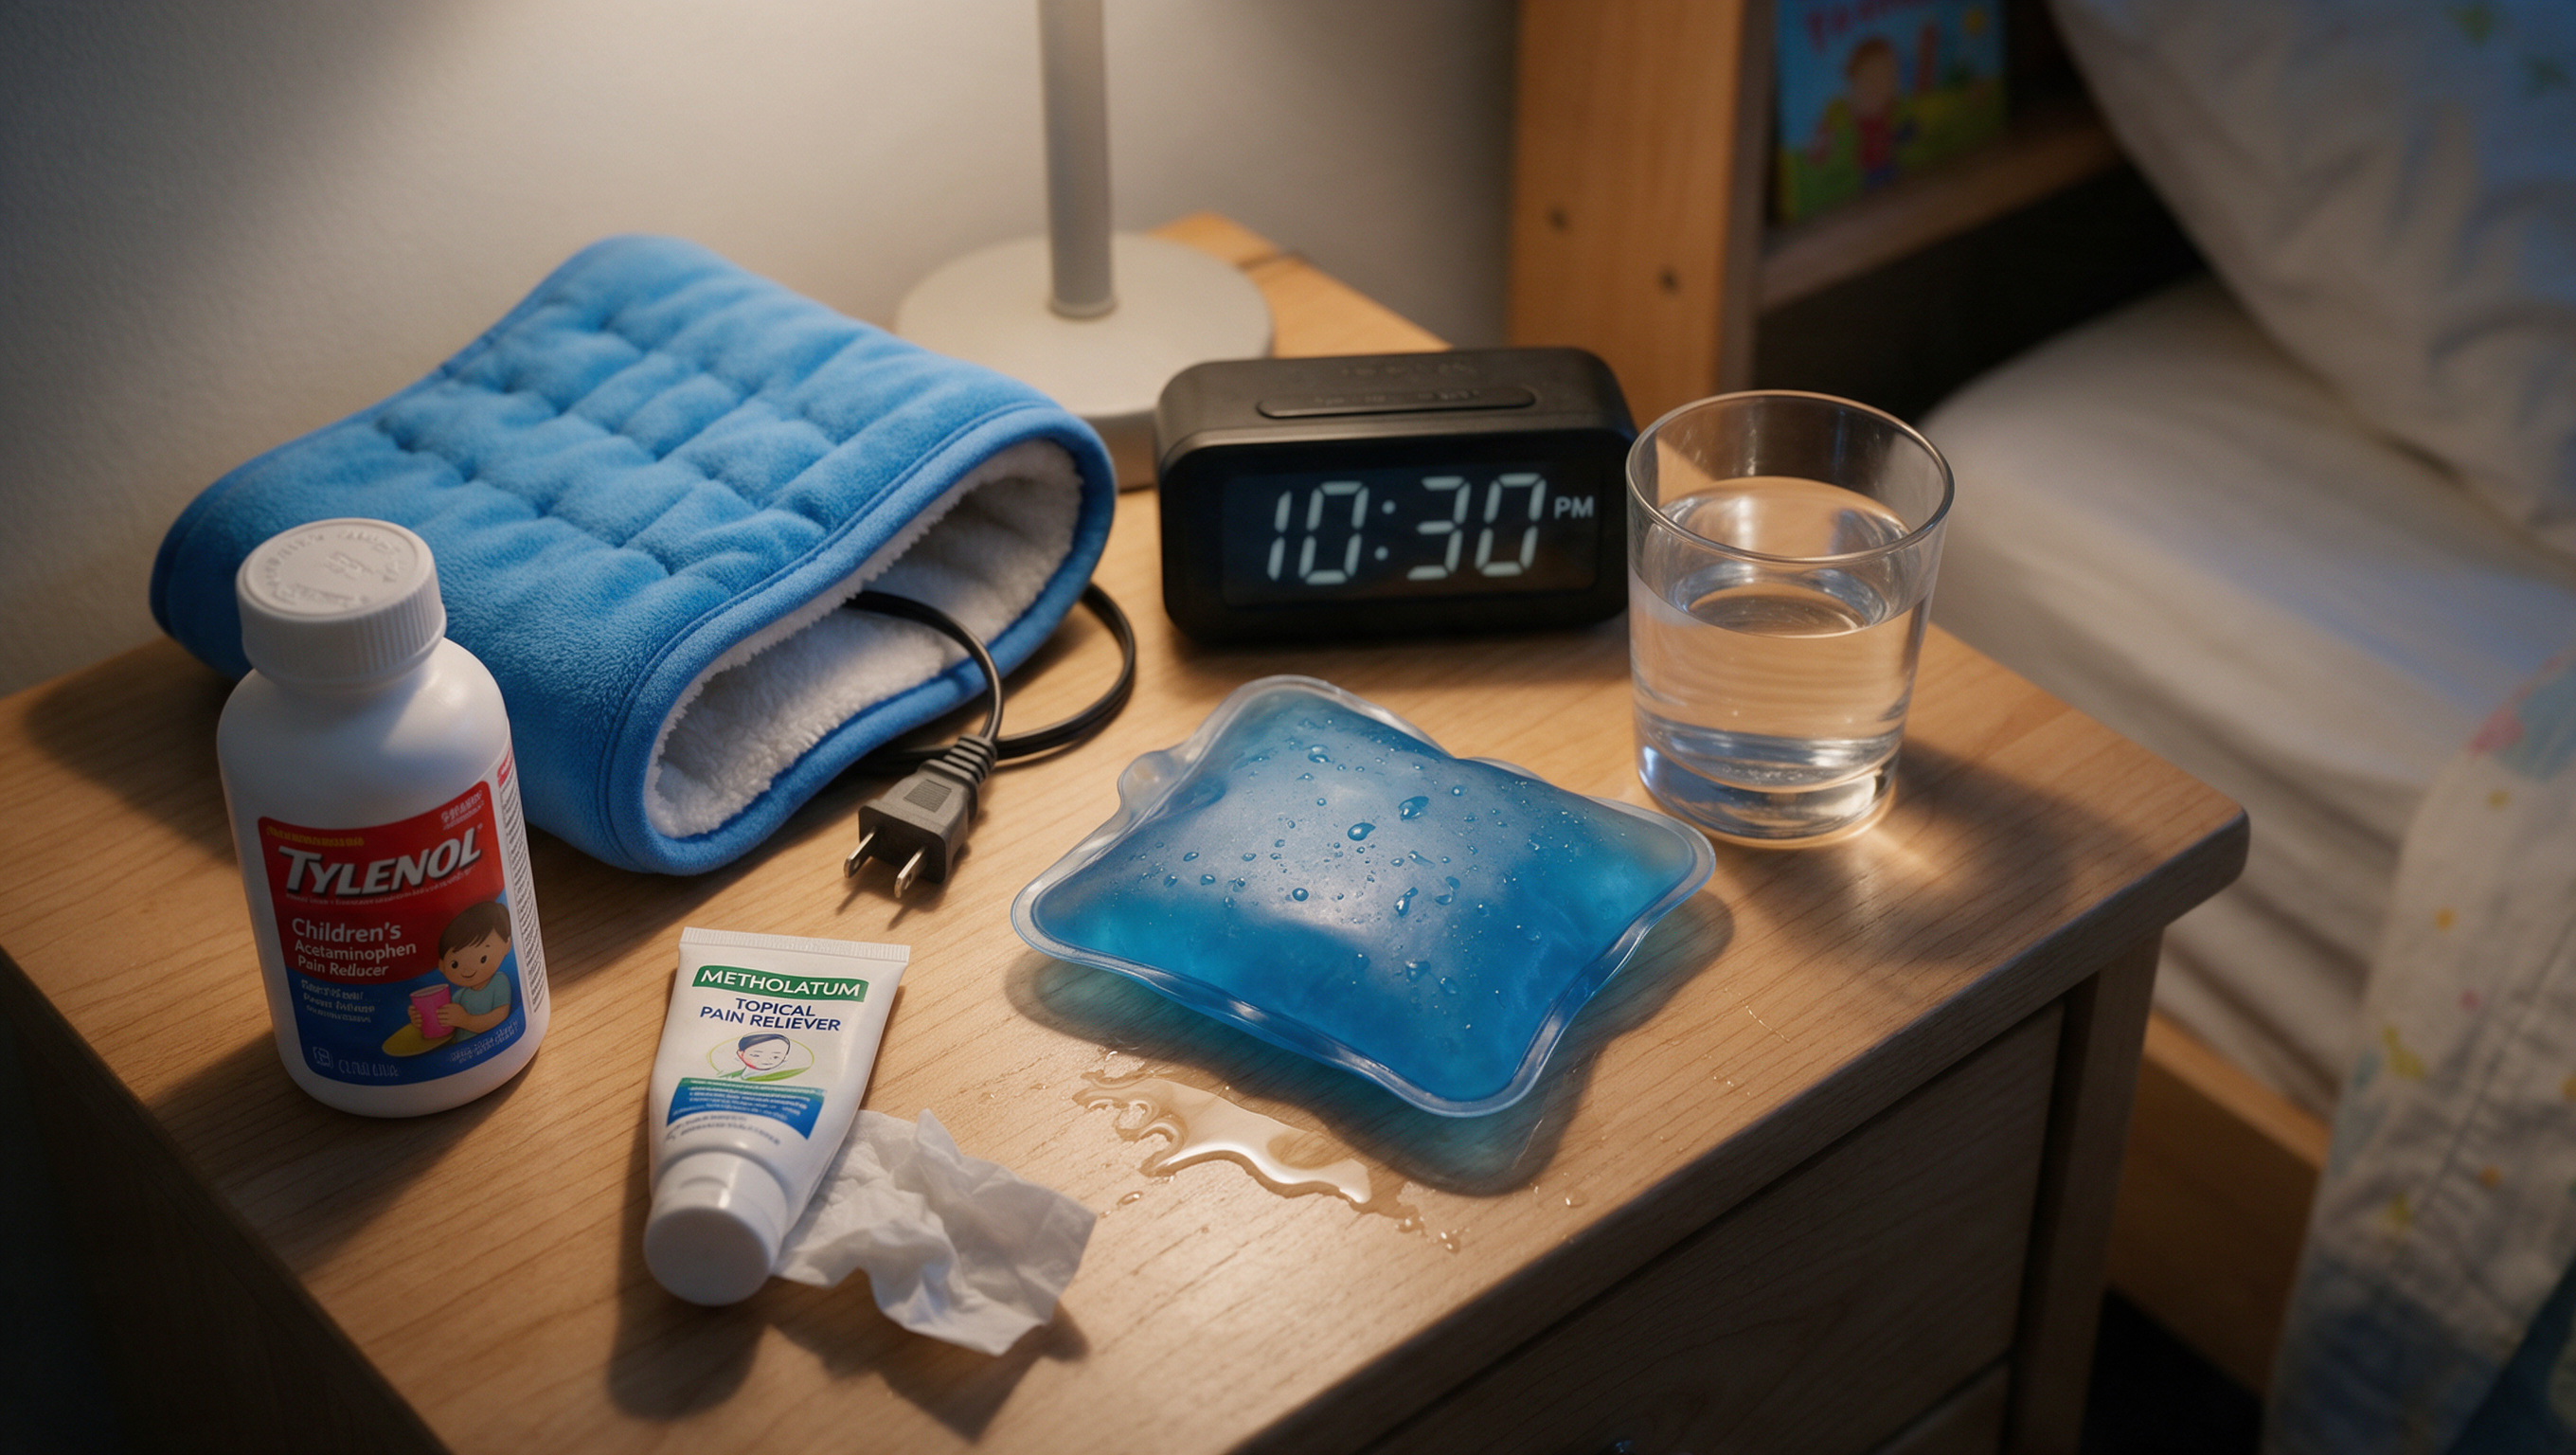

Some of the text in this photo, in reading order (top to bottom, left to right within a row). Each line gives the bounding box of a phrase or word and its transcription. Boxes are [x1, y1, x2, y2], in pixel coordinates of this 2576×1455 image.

[1266, 473, 1595, 585] 10:30 PM
[277, 826, 483, 896] TYLENOL
[292, 917, 402, 943] Children's
[295, 939, 418, 964] Acetaminophen
[297, 954, 326, 975] Pain
[700, 969, 861, 997] METHOLATUM
[699, 1006, 842, 1032] PAIN RELIEVER
[735, 997, 816, 1017] TOPICAL
